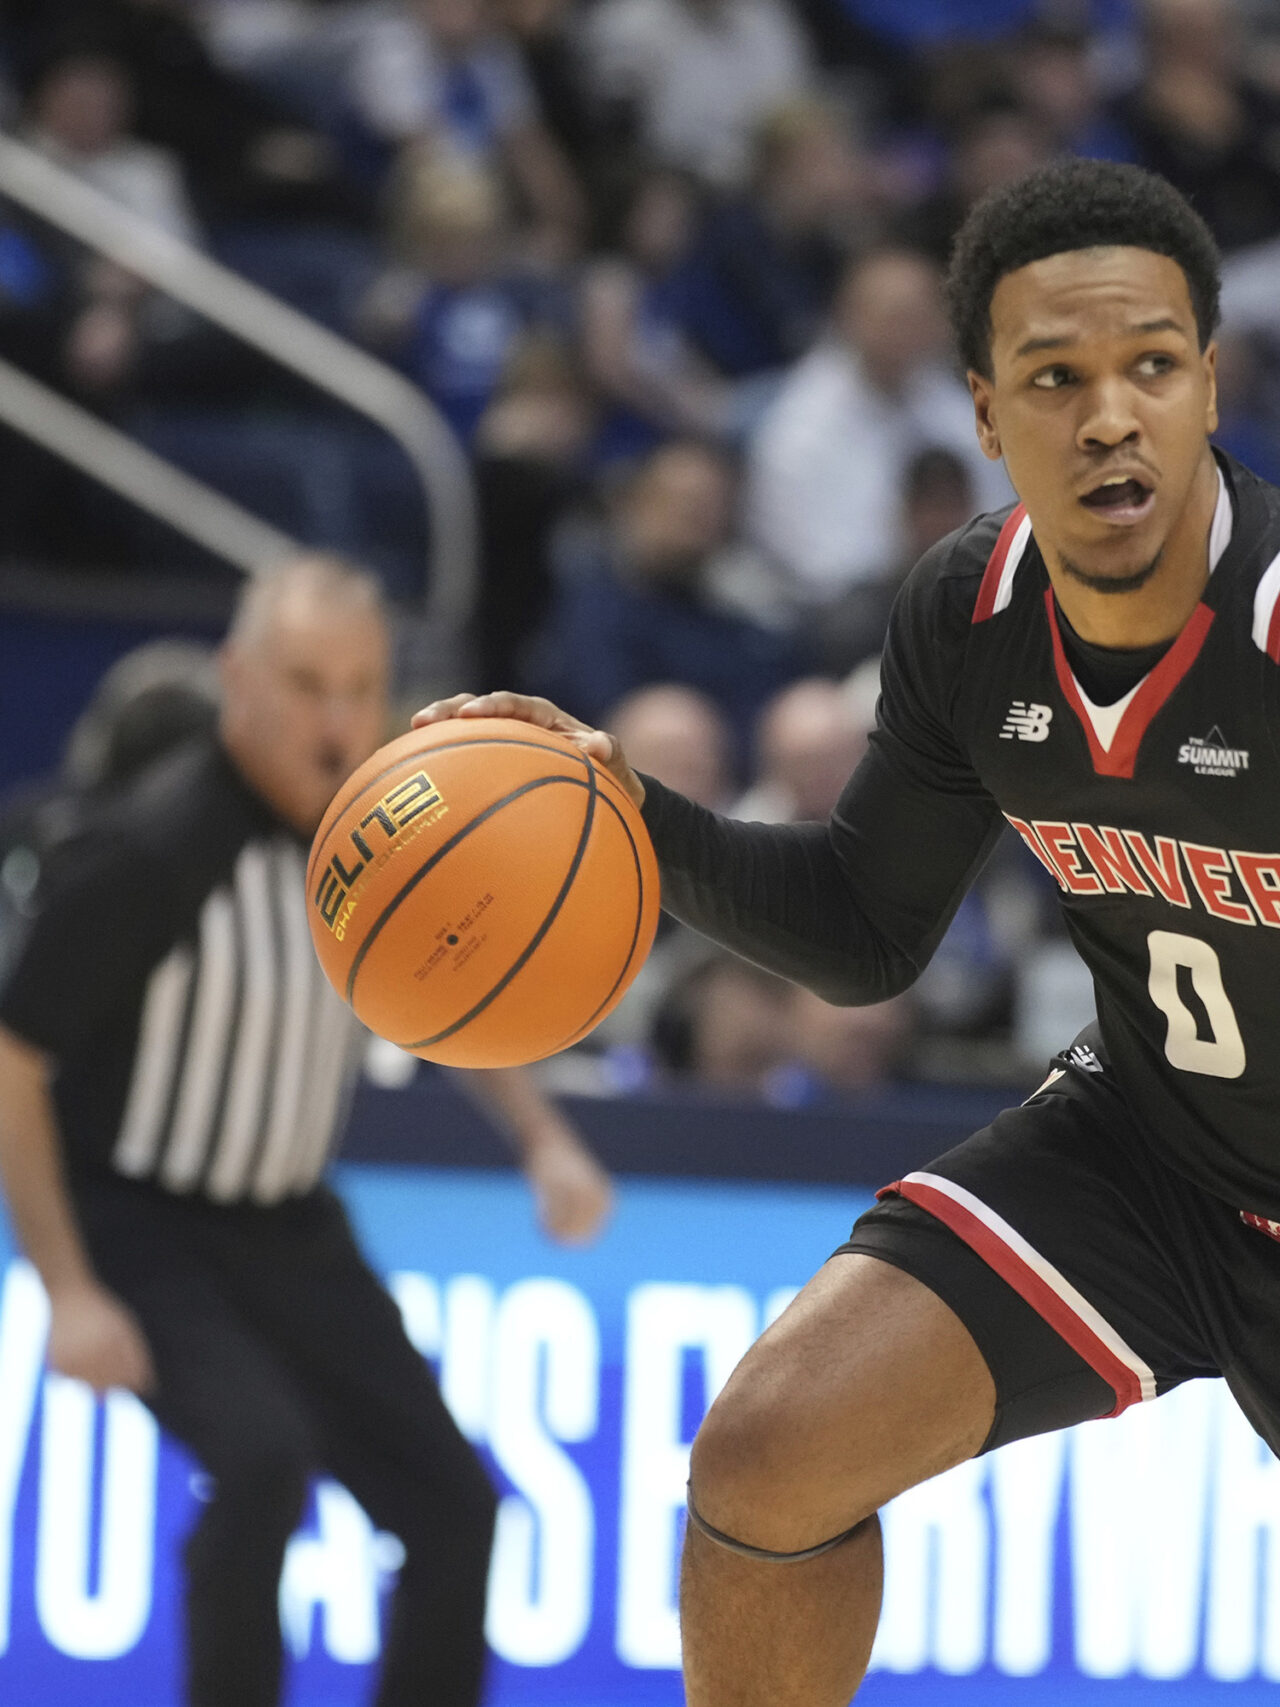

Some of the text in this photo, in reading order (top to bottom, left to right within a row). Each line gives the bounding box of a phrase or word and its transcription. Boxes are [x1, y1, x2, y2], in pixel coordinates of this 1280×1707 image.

[1178, 745, 1249, 769] SUMMIT
[1194, 766, 1236, 777] LEAGUE
[315, 769, 444, 933] ELITE
[1147, 929, 1247, 1080] 0
